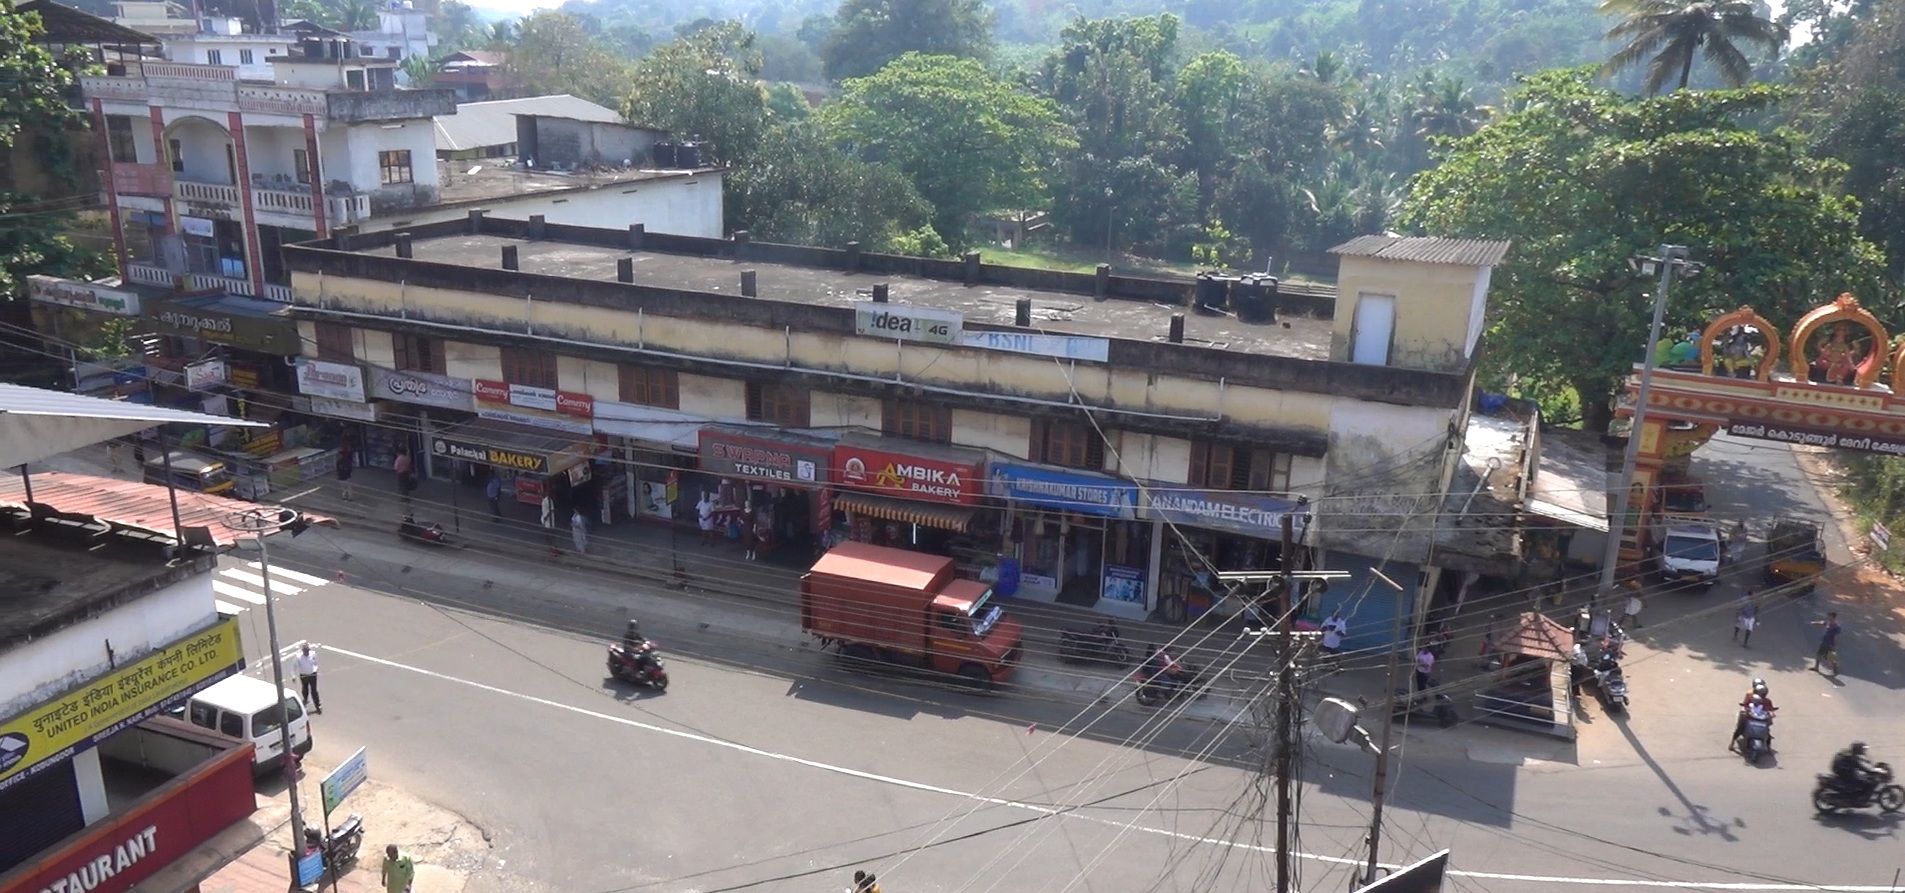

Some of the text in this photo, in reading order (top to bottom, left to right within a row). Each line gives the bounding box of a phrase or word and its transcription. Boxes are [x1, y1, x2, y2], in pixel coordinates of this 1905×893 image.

[928, 325, 949, 336] 4G
[488, 449, 543, 470] BAKERY
[711, 442, 792, 468] SWAPNA
[735, 462, 791, 481] TEXTILES
[875, 462, 961, 489] AMBIKA
[911, 482, 961, 498] BAKERY
[1077, 489, 1108, 504] STORES
[1151, 494, 1221, 518] ANANDAM
[186, 632, 223, 659] लिमिटेड
[47, 711, 89, 739] UNITED
[90, 697, 120, 718] INDIA
[121, 671, 178, 704] INSURANCE
[38, 824, 158, 893] TAURANT
